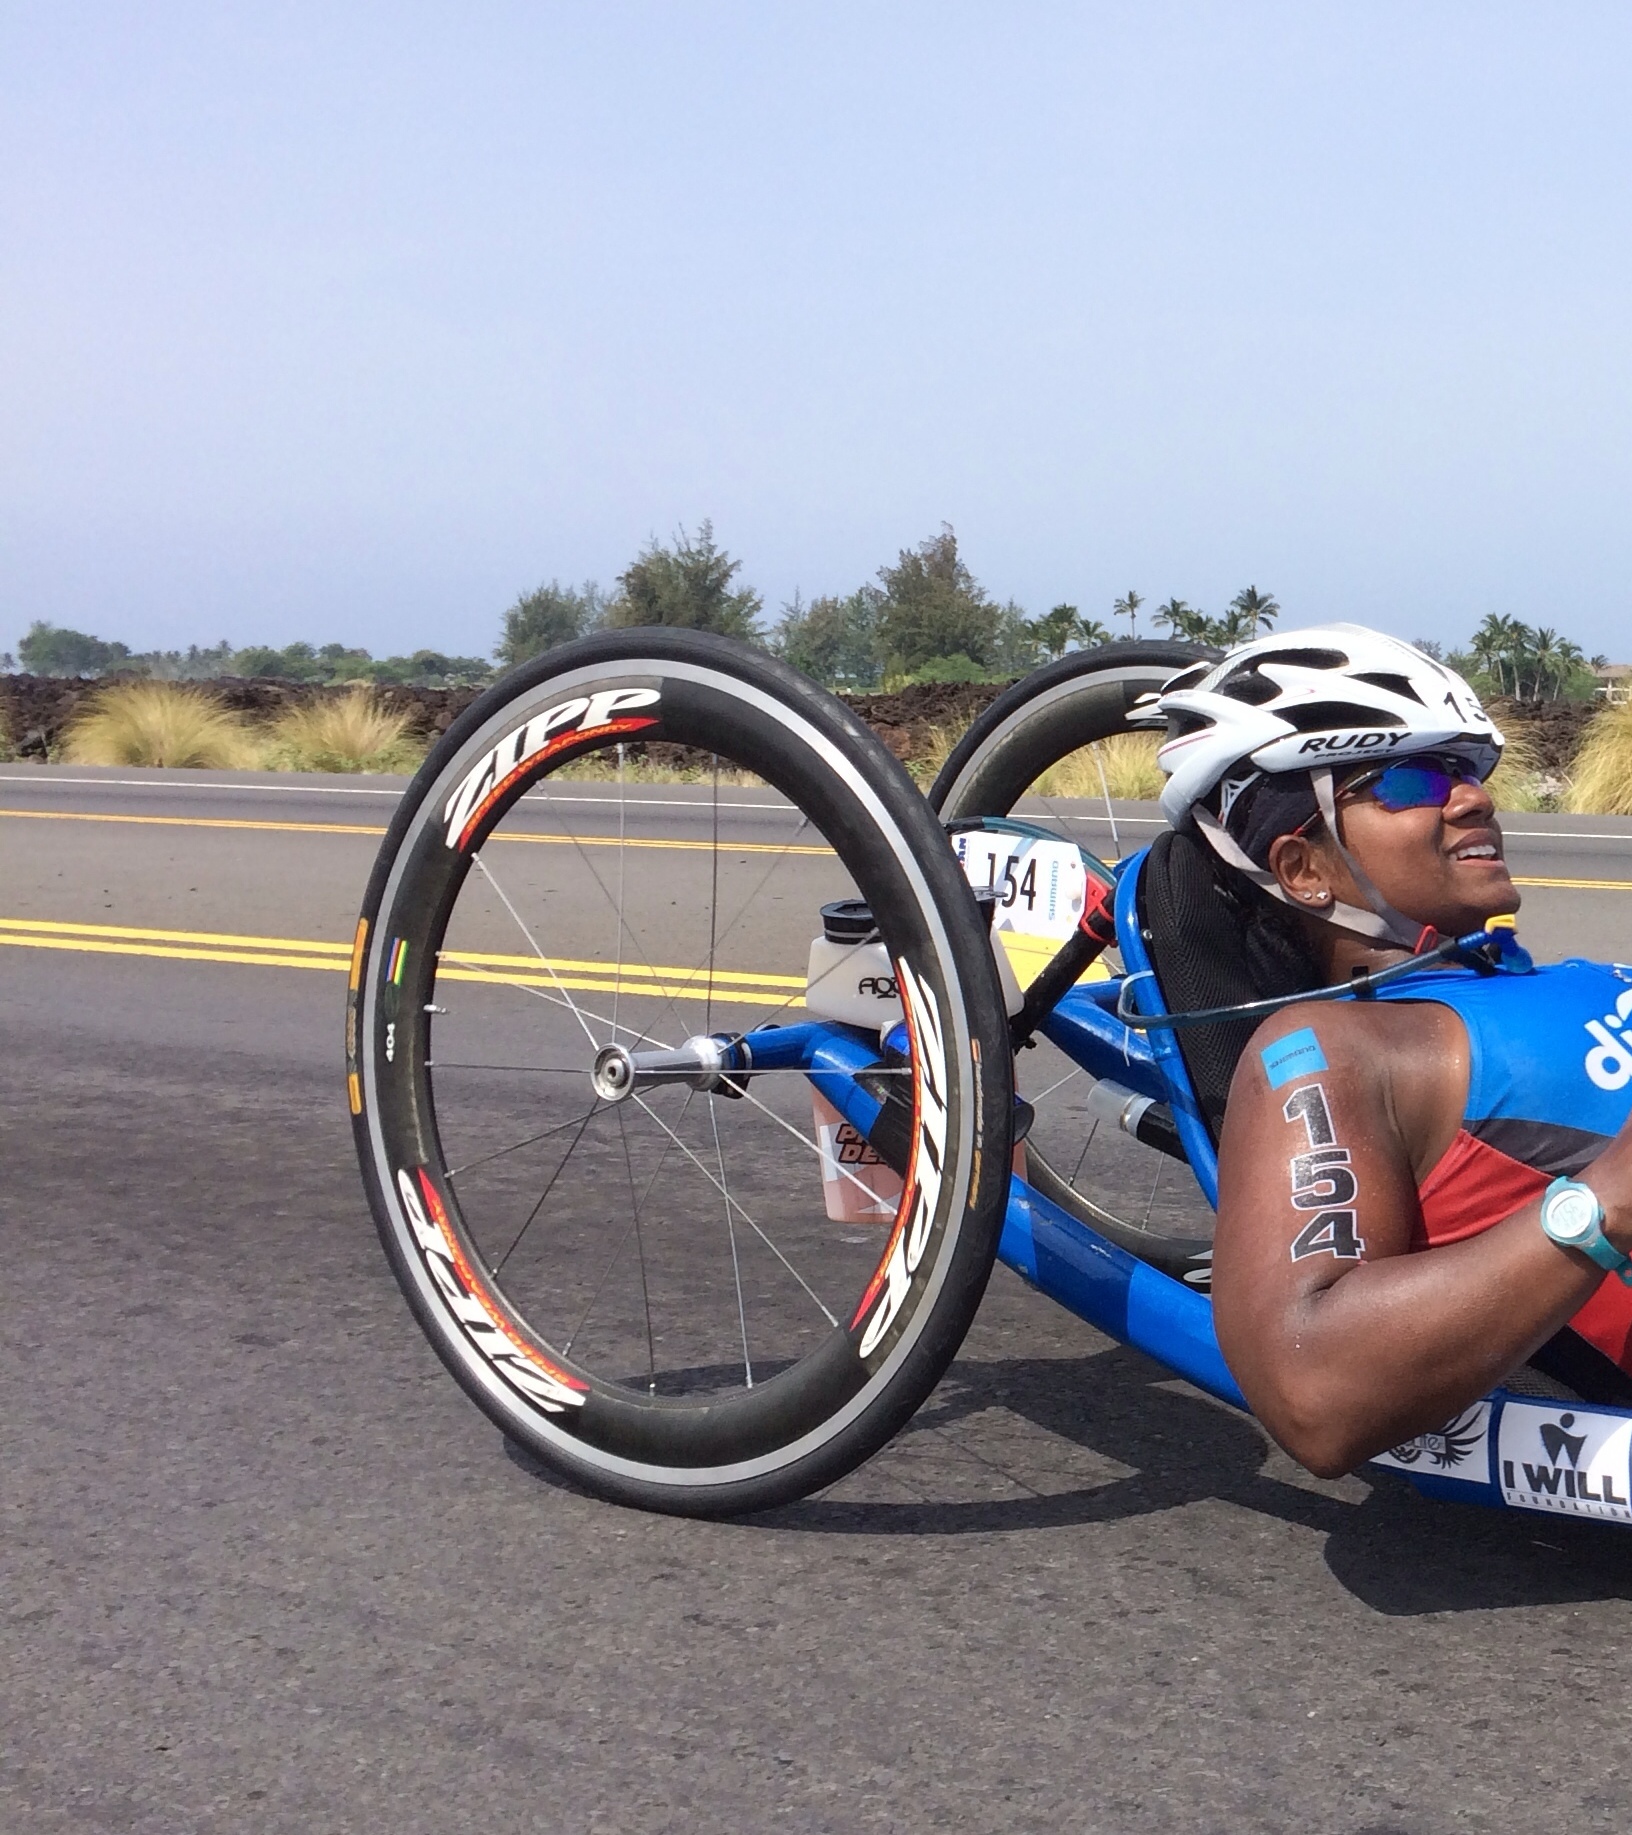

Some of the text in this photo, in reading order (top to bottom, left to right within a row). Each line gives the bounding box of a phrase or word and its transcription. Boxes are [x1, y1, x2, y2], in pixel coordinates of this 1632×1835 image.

[443, 688, 661, 849] ZIPP
[1298, 732, 1412, 755] RUDY
[1313, 748, 1395, 759] PROJECT
[987, 852, 1037, 911] 154
[1282, 1083, 1366, 1262] 154
[1503, 1460, 1628, 1506] I WILL
